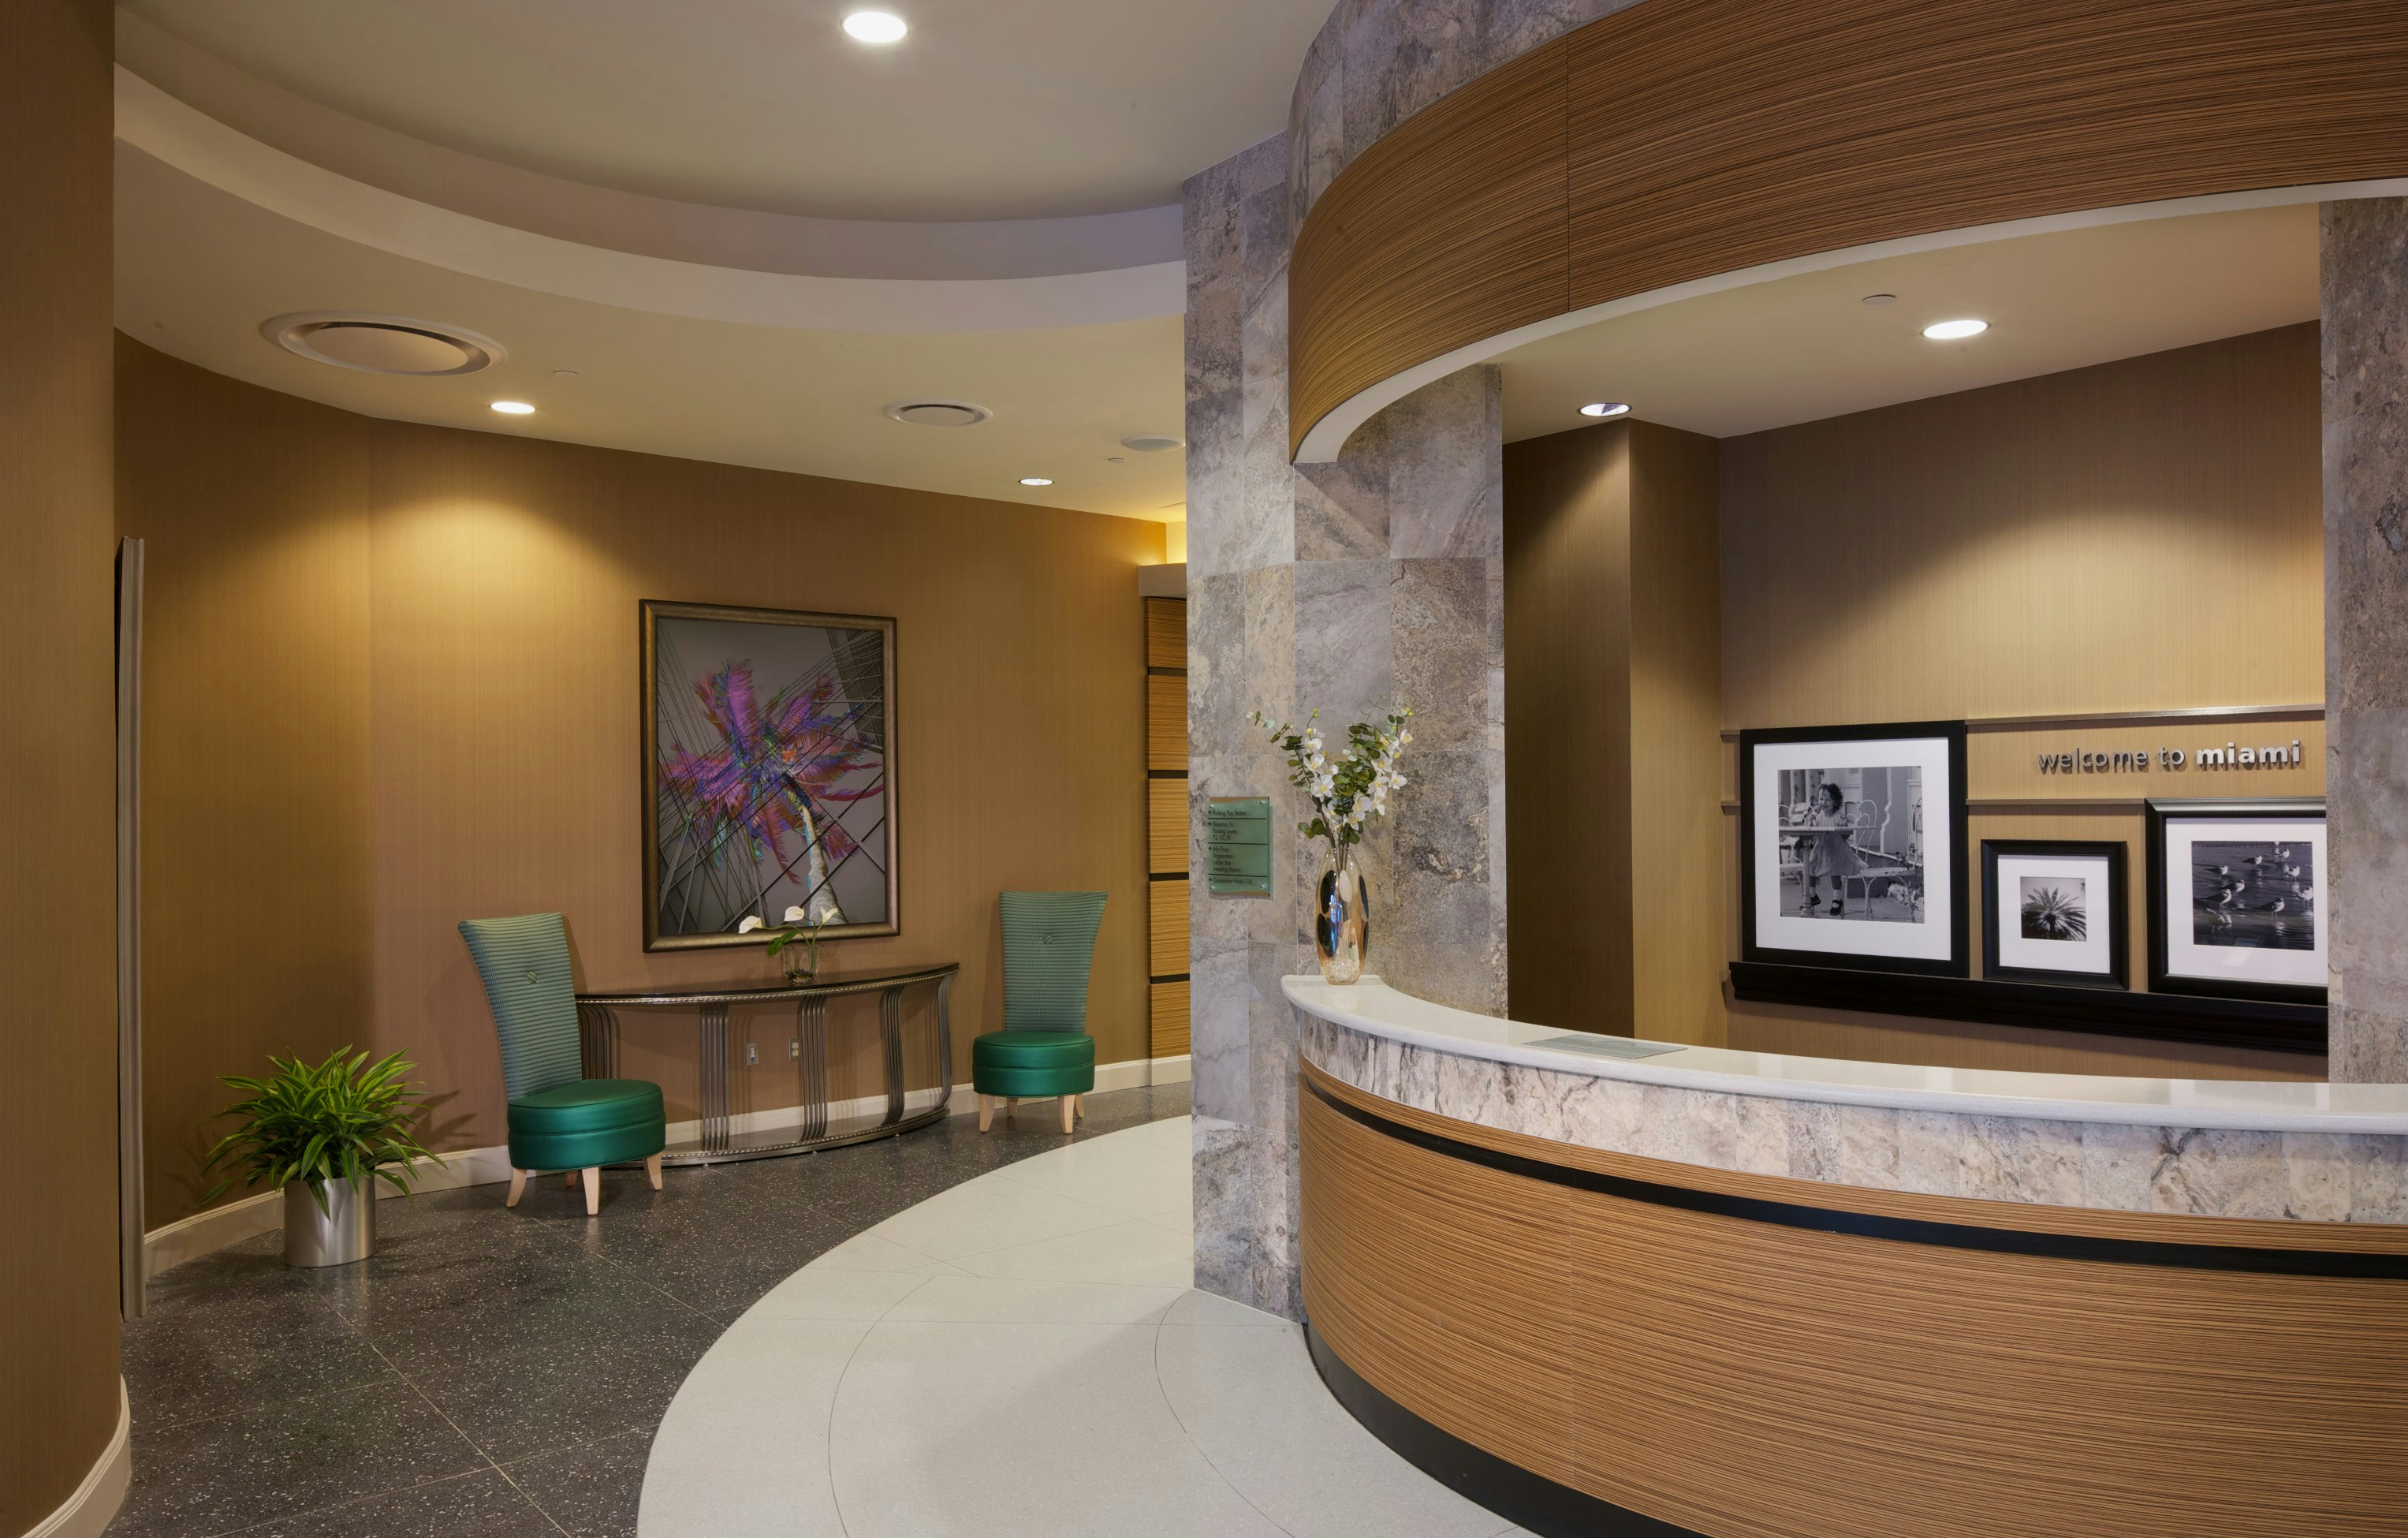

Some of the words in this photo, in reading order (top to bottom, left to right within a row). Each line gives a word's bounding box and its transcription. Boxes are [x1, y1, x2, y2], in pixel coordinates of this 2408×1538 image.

[2038, 748, 2149, 768] welcome
[2158, 746, 2185, 765] to
[2196, 740, 2301, 764] miami
